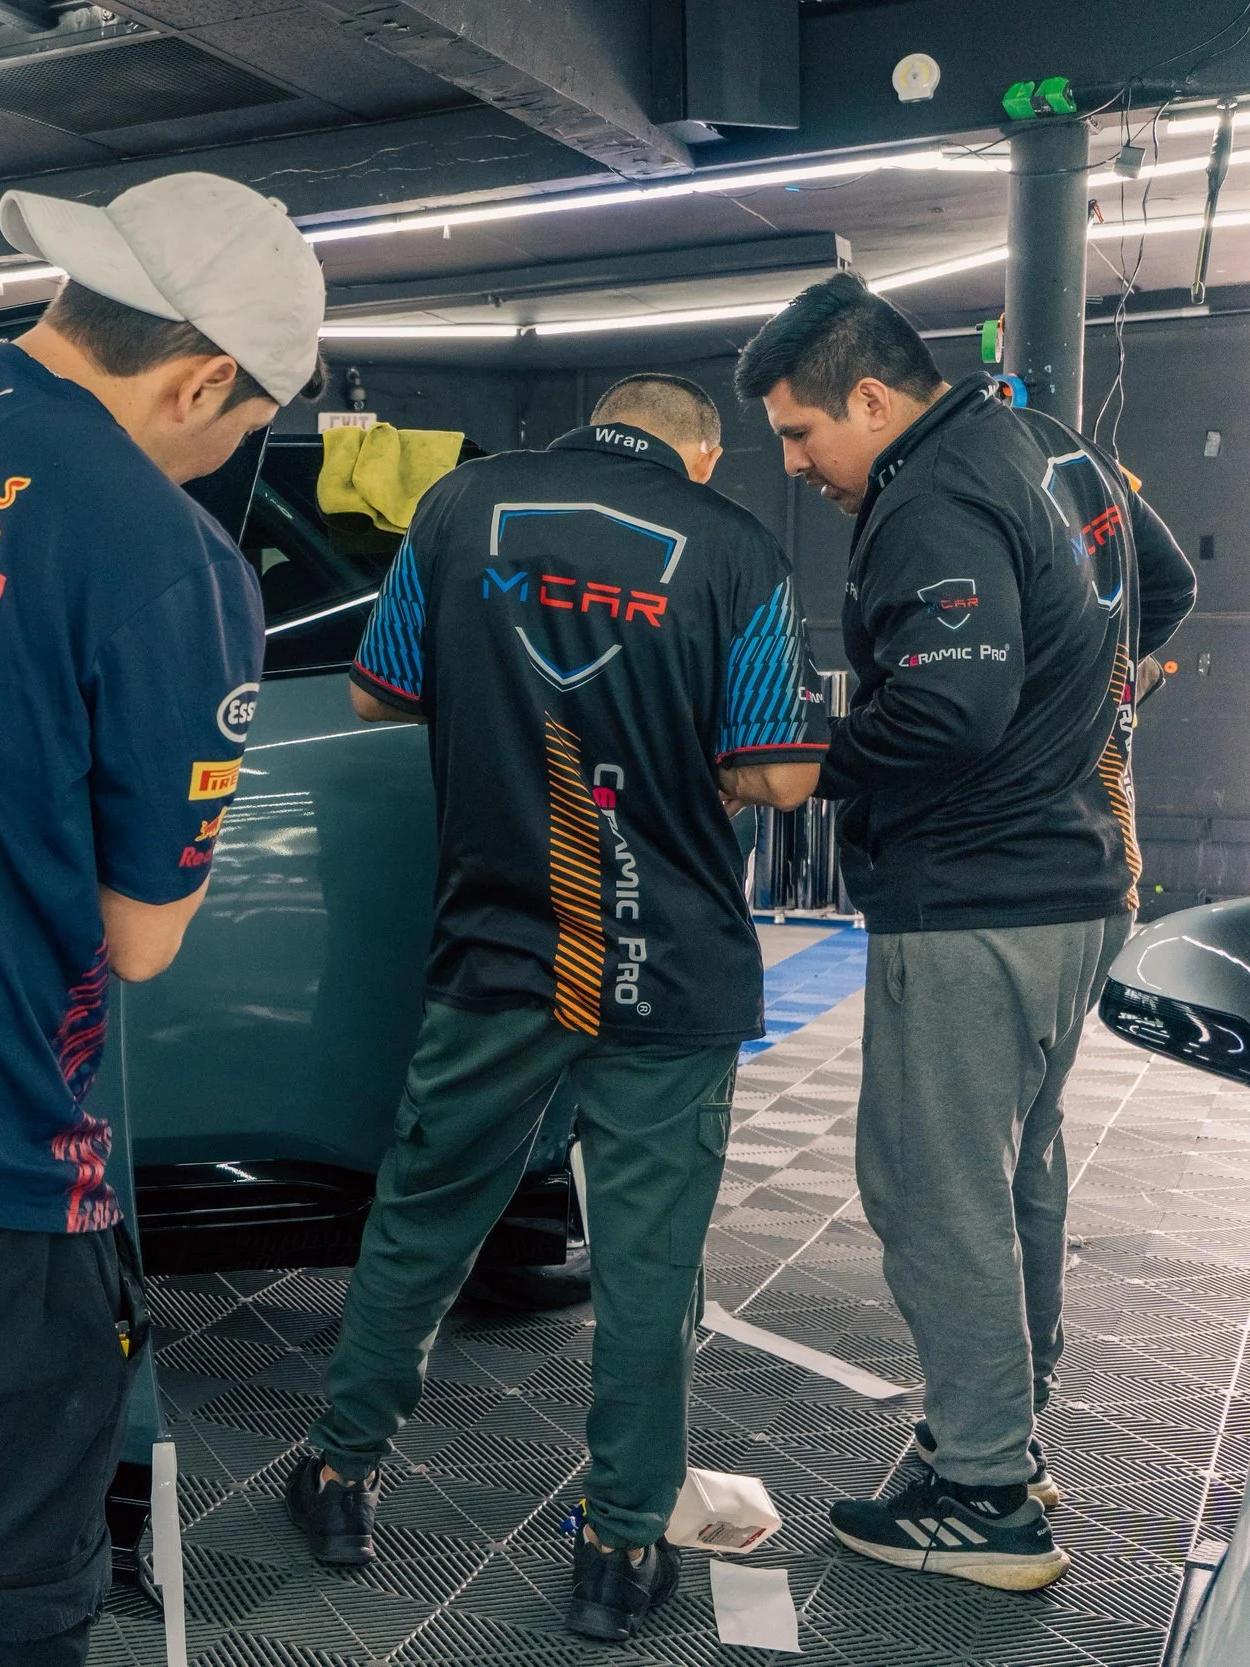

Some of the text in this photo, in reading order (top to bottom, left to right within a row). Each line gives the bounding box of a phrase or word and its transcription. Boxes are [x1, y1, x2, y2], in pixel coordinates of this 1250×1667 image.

[595, 427, 649, 453] Wrap
[228, 699, 256, 725] Ess
[199, 767, 239, 791] PIRE
